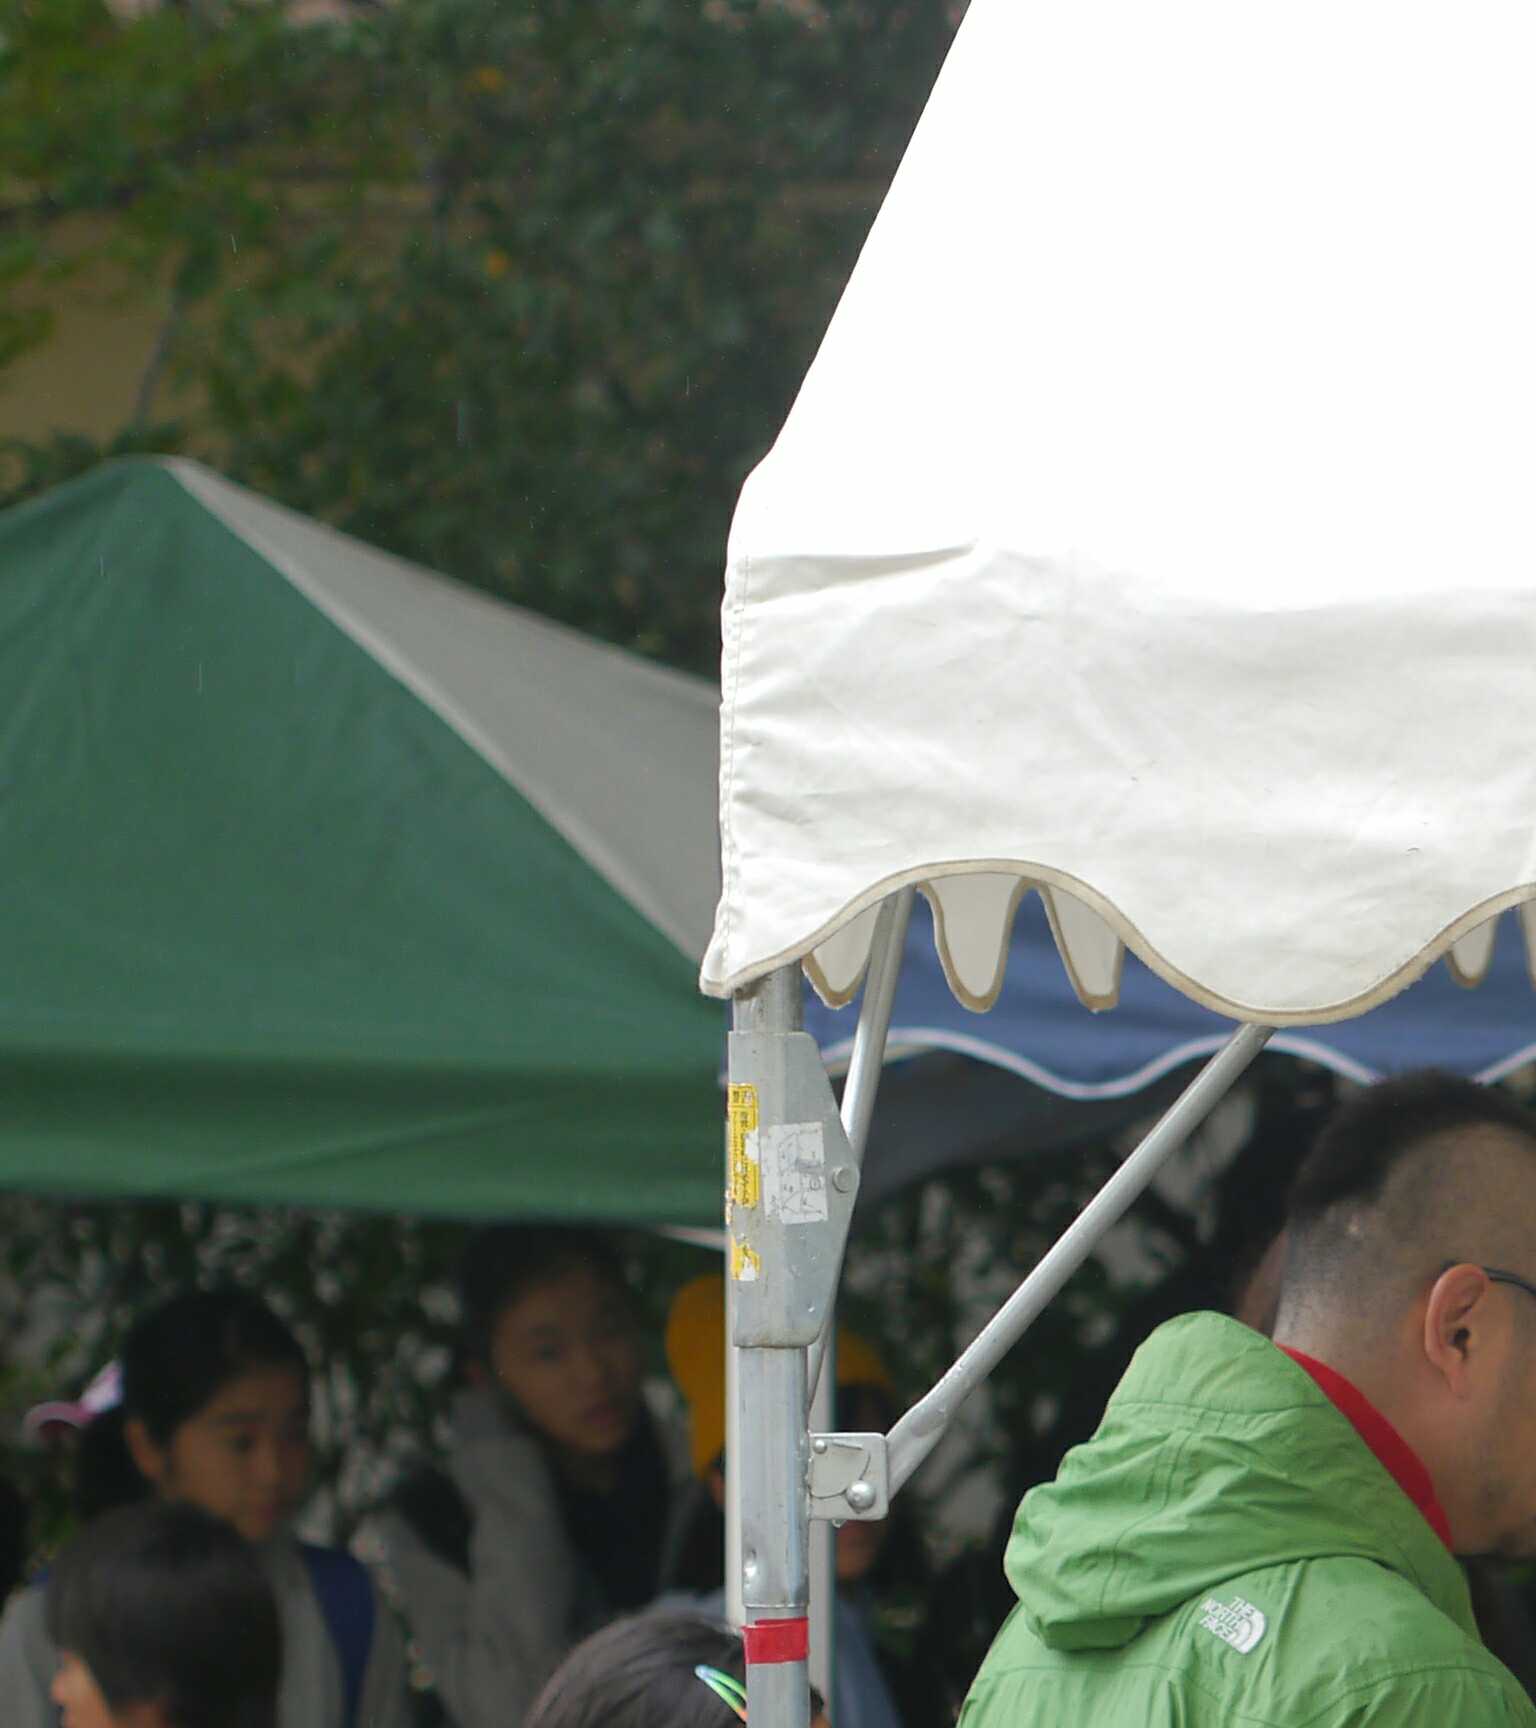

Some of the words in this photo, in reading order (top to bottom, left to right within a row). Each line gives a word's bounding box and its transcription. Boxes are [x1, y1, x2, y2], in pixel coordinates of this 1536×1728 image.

[1201, 1598, 1244, 1632] NORTH
[1229, 1596, 1256, 1618] THE
[1199, 1614, 1235, 1641] FACE
